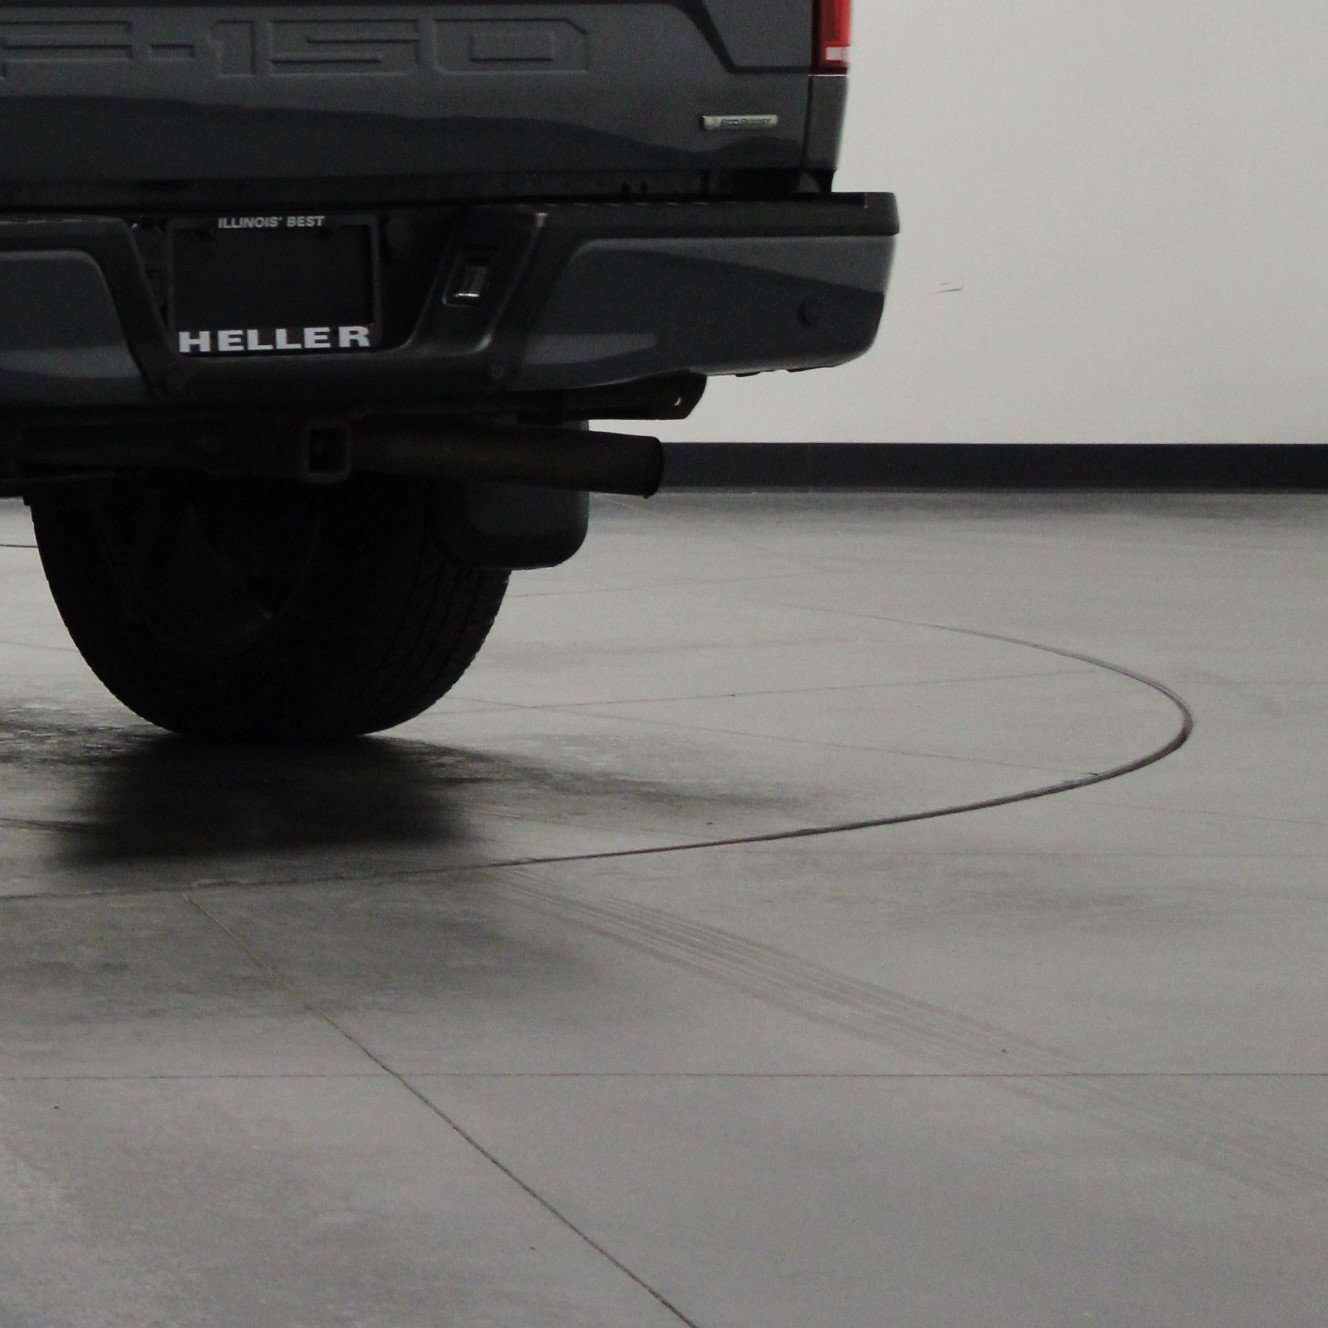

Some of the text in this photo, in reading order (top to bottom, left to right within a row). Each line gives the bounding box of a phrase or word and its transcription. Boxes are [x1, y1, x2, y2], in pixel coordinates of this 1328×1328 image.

[217, 215, 325, 229] ILLINOIS' BEST
[178, 325, 371, 353] HELLER
